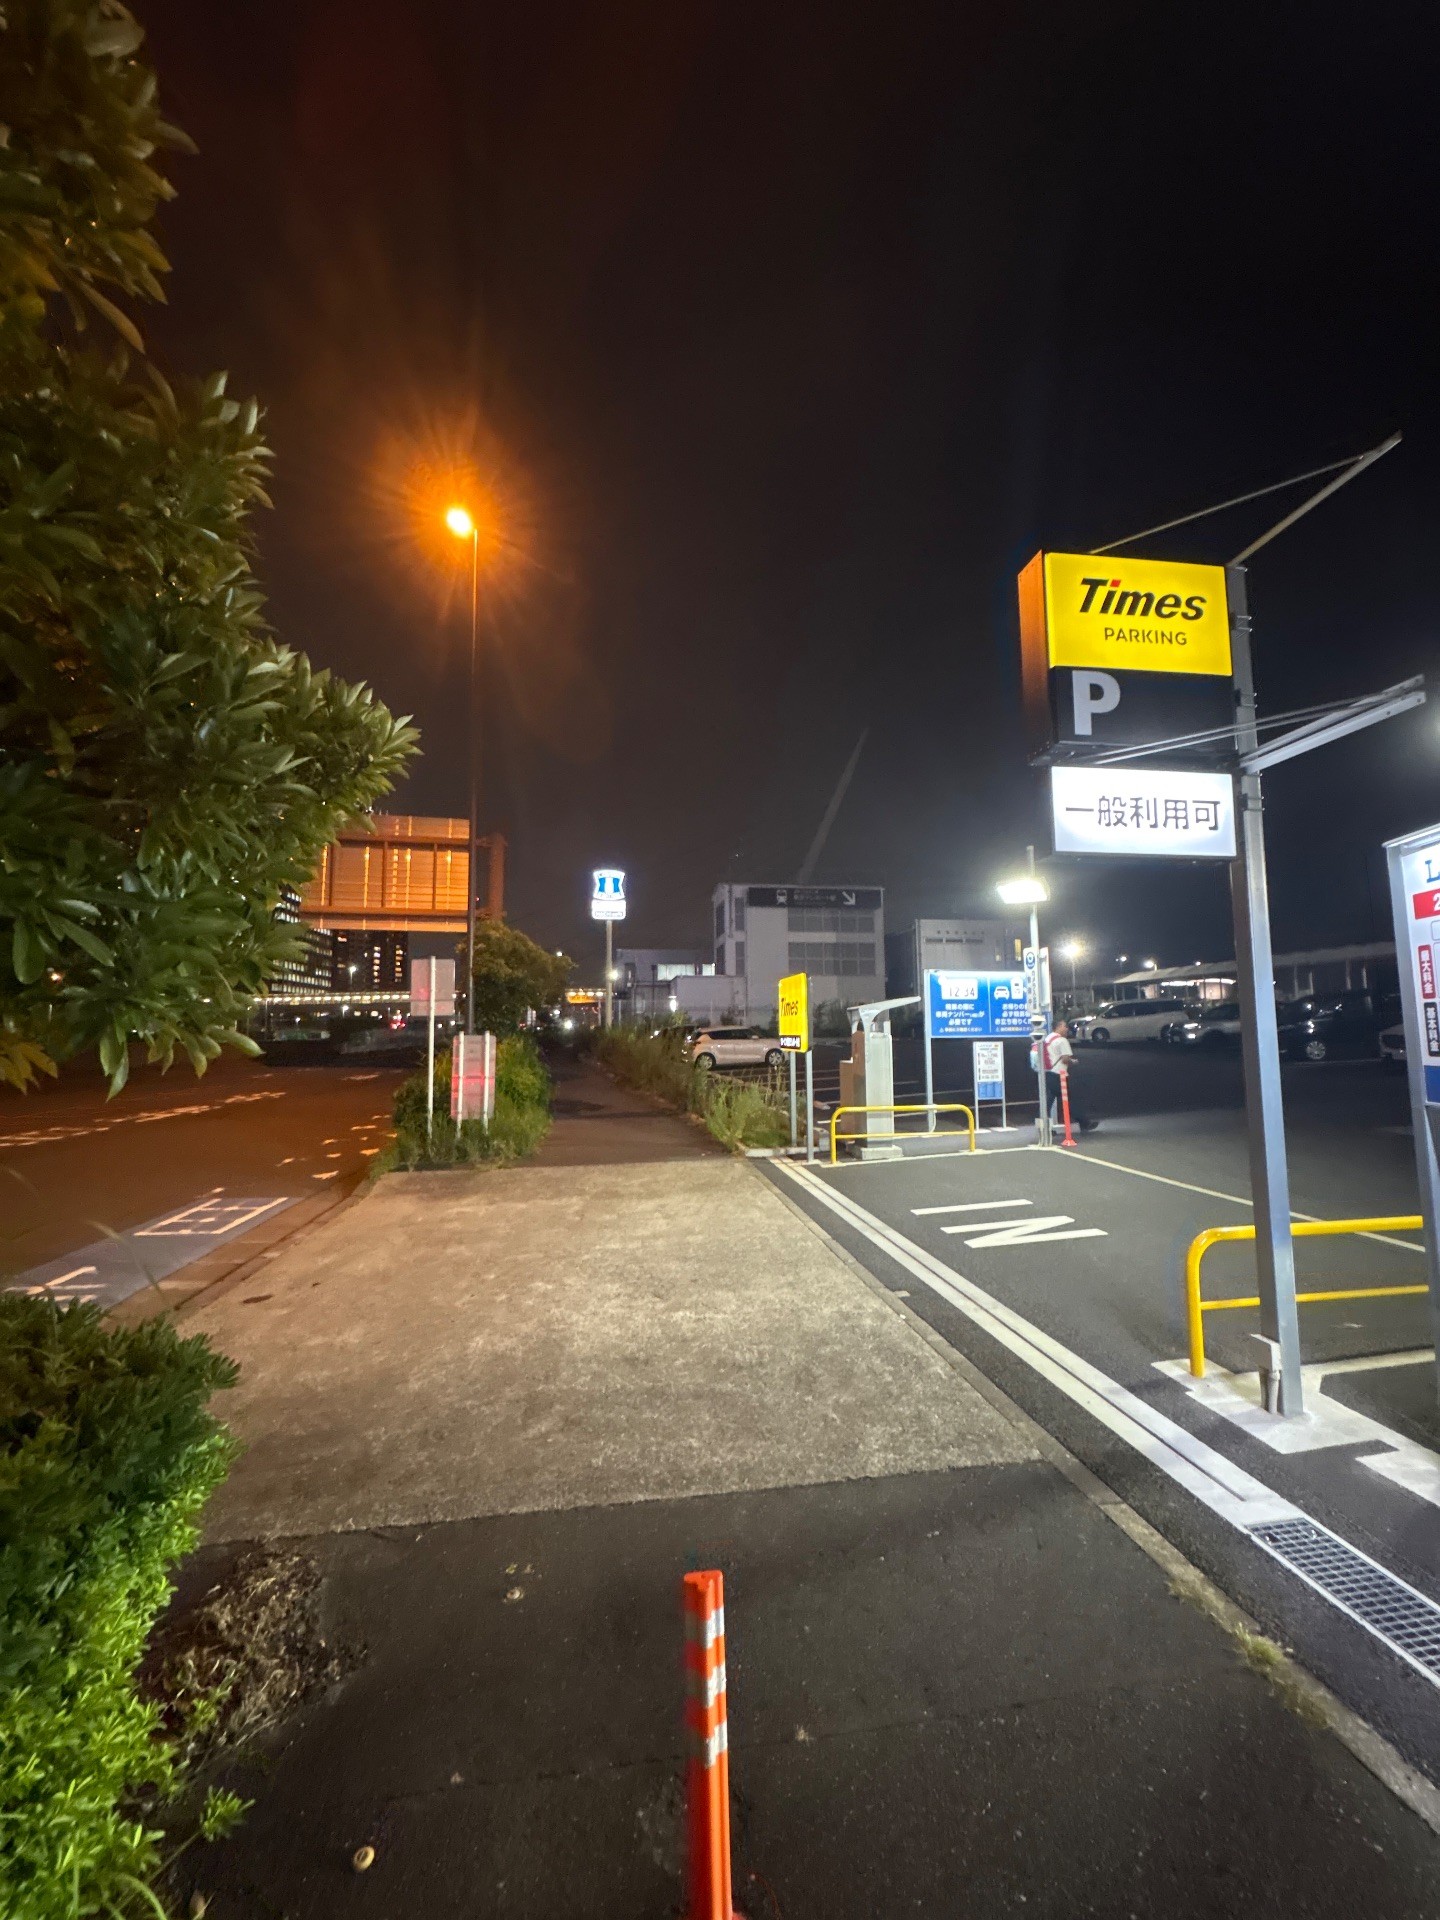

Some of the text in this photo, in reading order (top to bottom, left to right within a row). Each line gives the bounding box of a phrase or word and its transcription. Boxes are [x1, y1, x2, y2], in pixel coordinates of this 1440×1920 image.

[1079, 577, 1207, 621] Times
[1104, 627, 1188, 646] PARKING
[1072, 670, 1121, 735] P
[1065, 795, 1221, 831] 一般利用可
[780, 997, 799, 1017] Times
[910, 1198, 1109, 1249] IN
